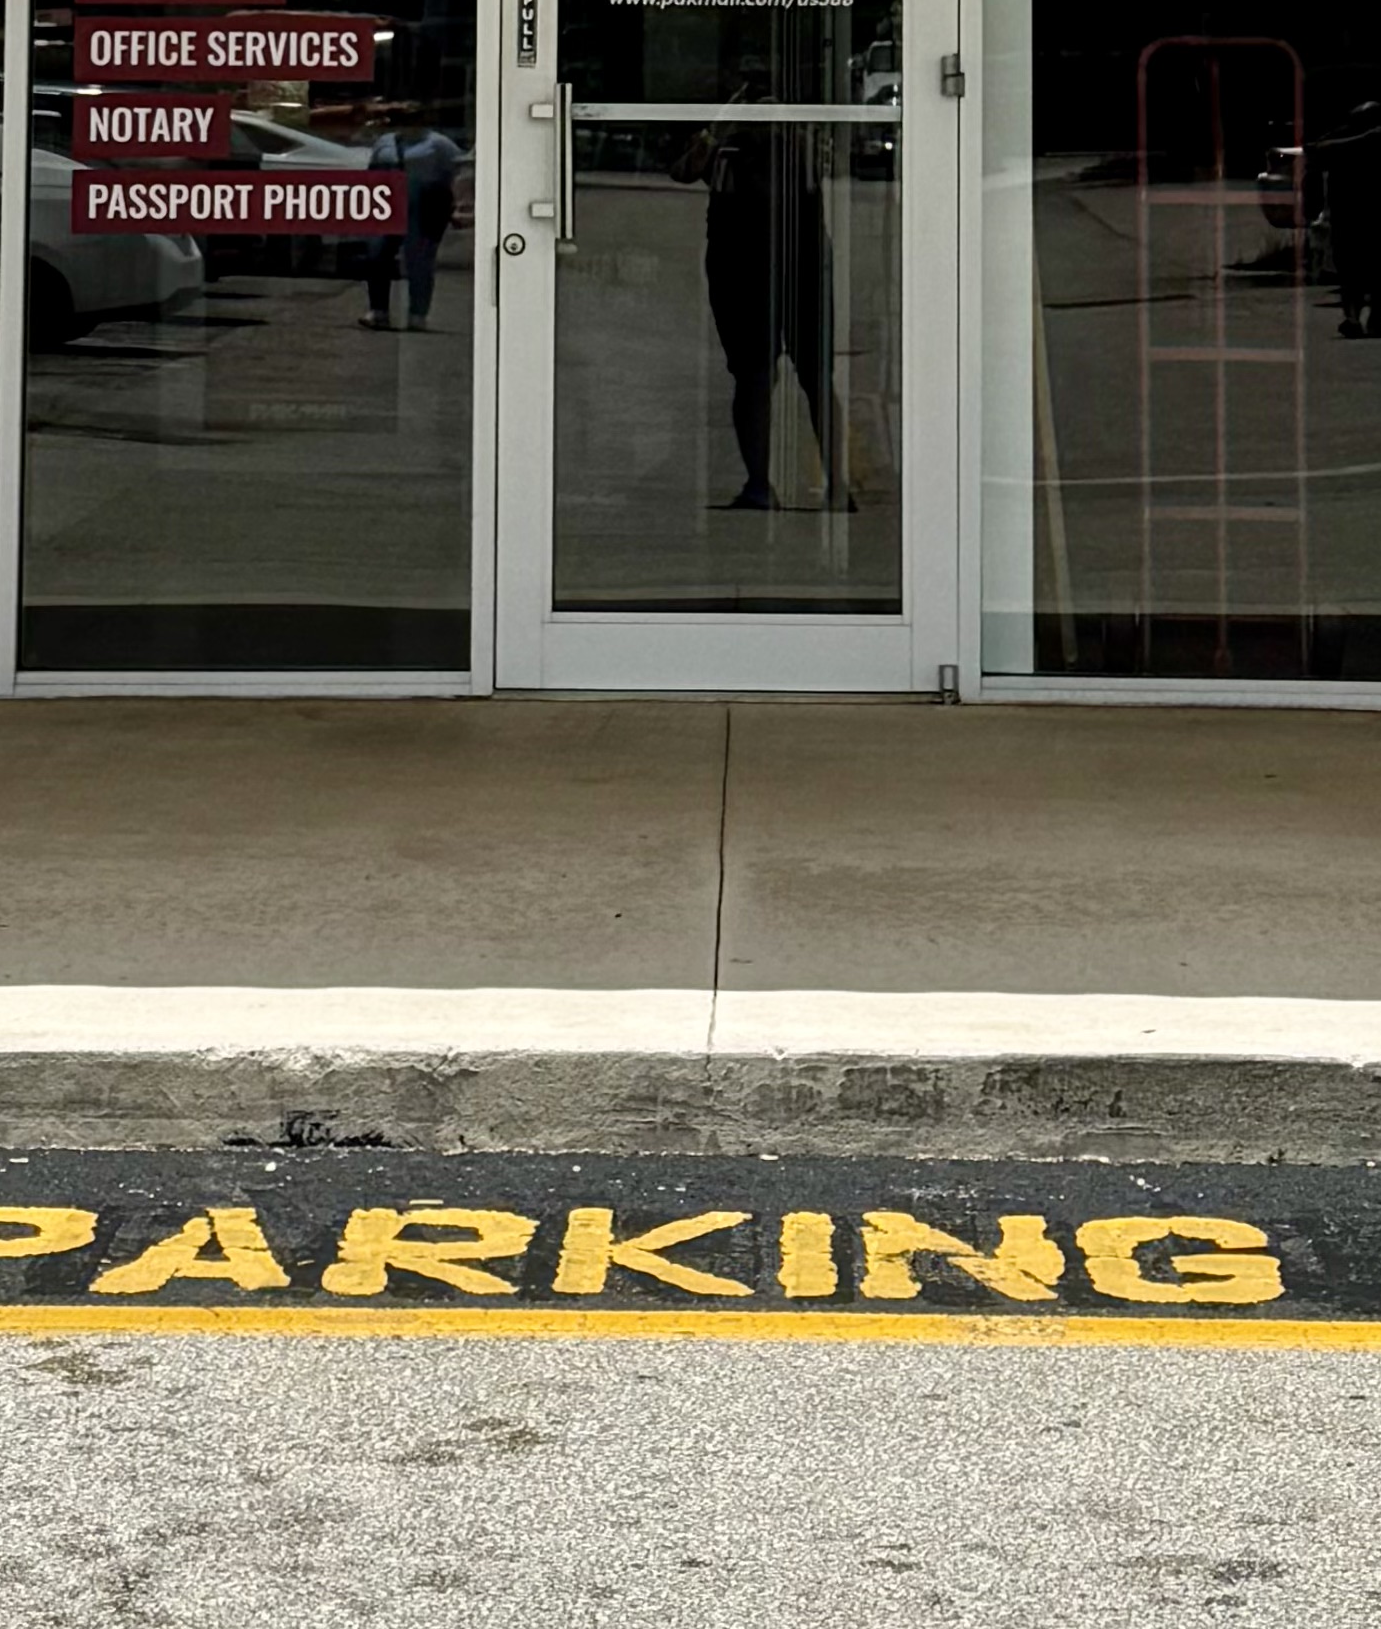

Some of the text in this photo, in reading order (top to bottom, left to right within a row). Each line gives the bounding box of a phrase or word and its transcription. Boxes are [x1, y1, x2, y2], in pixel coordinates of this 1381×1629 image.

[89, 30, 359, 68] OFFICE SERVICES
[88, 106, 214, 143] NOTARY
[87, 183, 392, 221] PASSPORT PHOTOS
